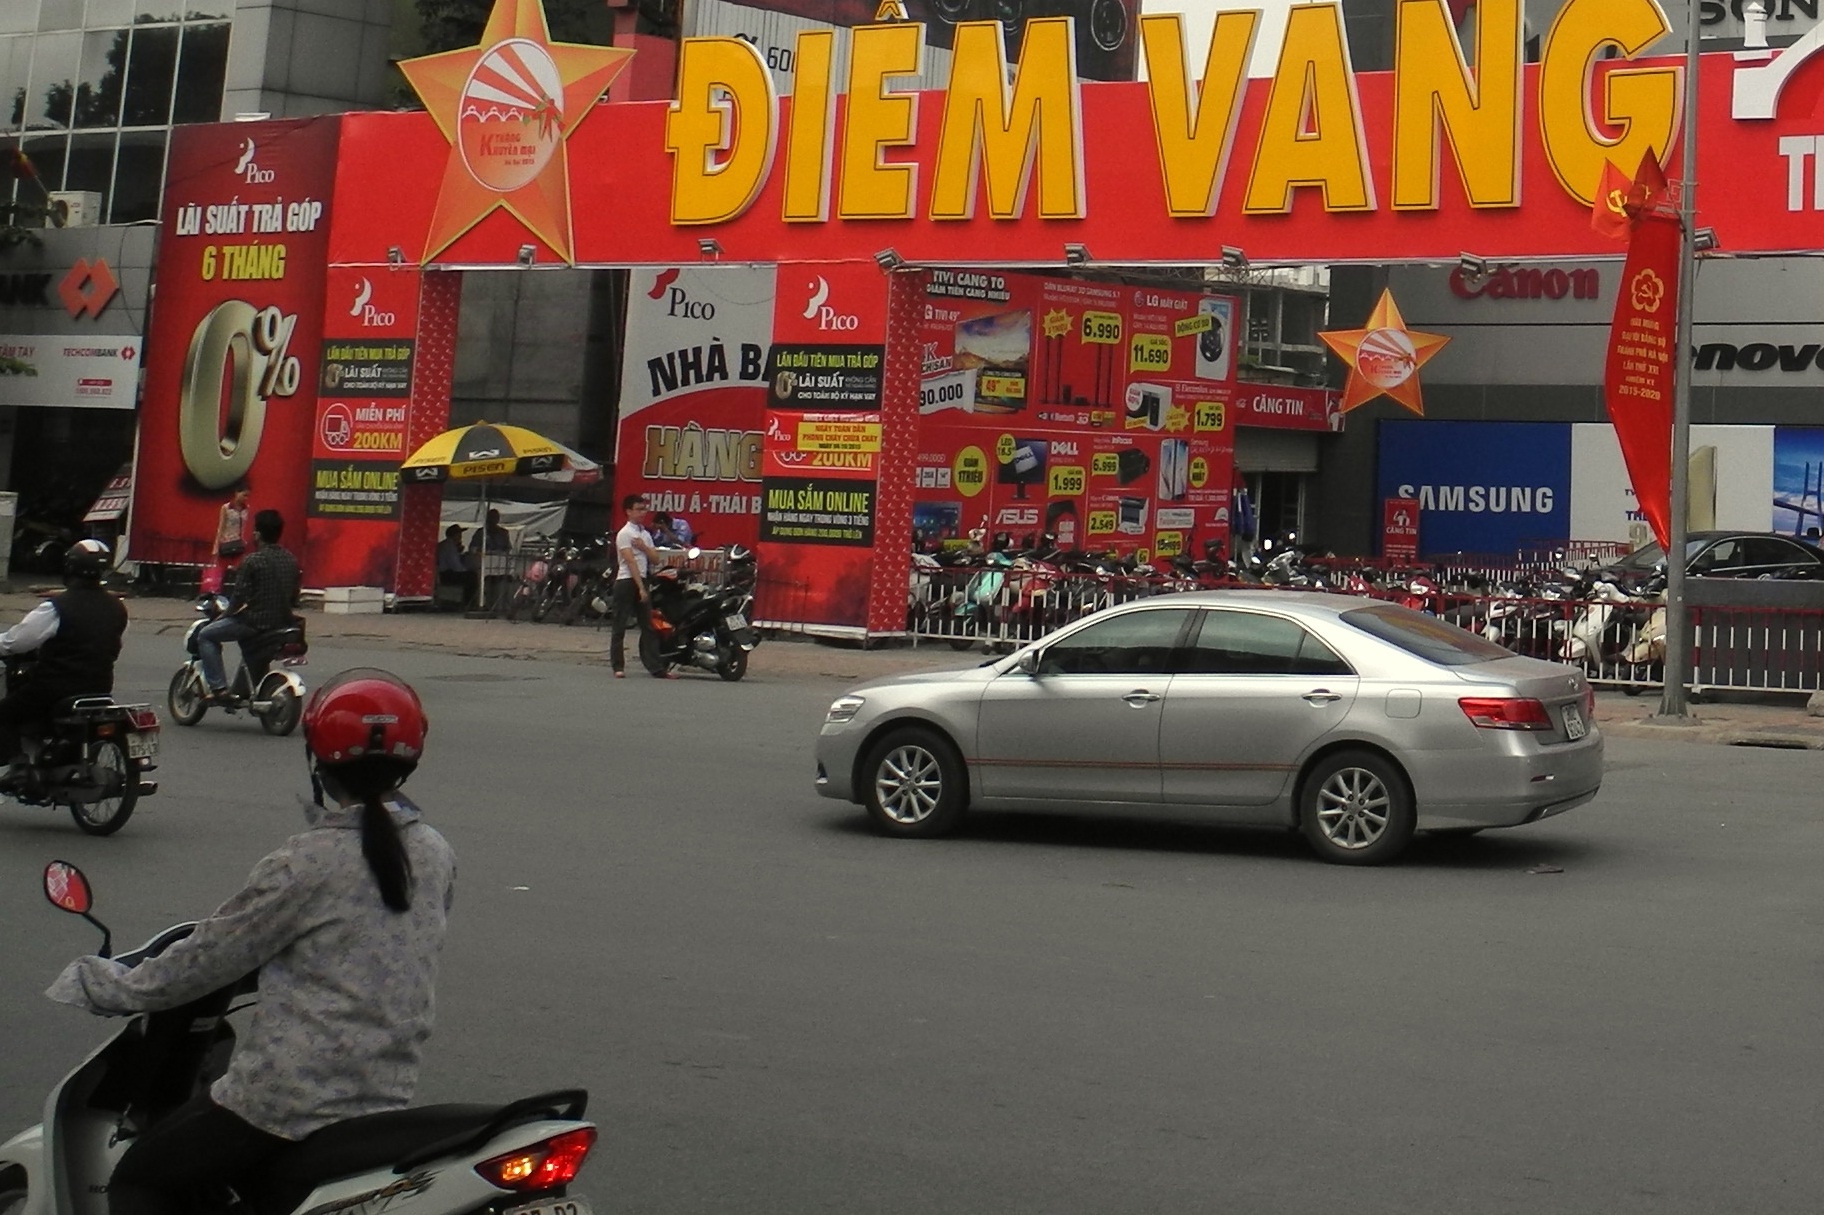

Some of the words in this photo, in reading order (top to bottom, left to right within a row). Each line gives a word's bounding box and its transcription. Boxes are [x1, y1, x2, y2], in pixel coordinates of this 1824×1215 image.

[245, 163, 275, 184] Pico
[176, 202, 202, 236] LÃI
[205, 195, 249, 235] SUẤT
[252, 196, 283, 234] TRẢ
[287, 197, 322, 232] GÓP
[202, 245, 217, 281] 6
[222, 240, 287, 281] THÁNG
[1450, 264, 1599, 300] Canon
[667, 287, 716, 321] Pico
[1146, 295, 1159, 307] LG
[362, 305, 395, 327] Pico
[819, 305, 859, 331] Pico
[1083, 318, 1120, 340] 6.990
[1133, 344, 1169, 364] 11.690
[647, 337, 730, 397] NHÀ
[799, 373, 815, 388] LÃI
[817, 371, 844, 388] SUẤT
[180, 298, 301, 490] 0%
[1618, 384, 1661, 401] 2015-2020
[386, 405, 406, 422] PHÍ
[1253, 393, 1283, 414] CĂNG
[1285, 399, 1304, 415] TIN
[1195, 413, 1223, 427] 1.799
[353, 433, 403, 449] 200KM
[1051, 442, 1079, 456] DELL
[463, 462, 506, 475] PISEN
[1093, 459, 1117, 472] 6.999
[364, 472, 399, 490] ONLINE
[1053, 474, 1083, 491] 1.999
[709, 492, 748, 514] THÁI
[768, 489, 795, 510] MUA
[797, 483, 824, 511] SẮM
[826, 491, 870, 513] ONLINE
[1398, 484, 1554, 514] SAMSUNG
[995, 509, 1039, 525] ASUS
